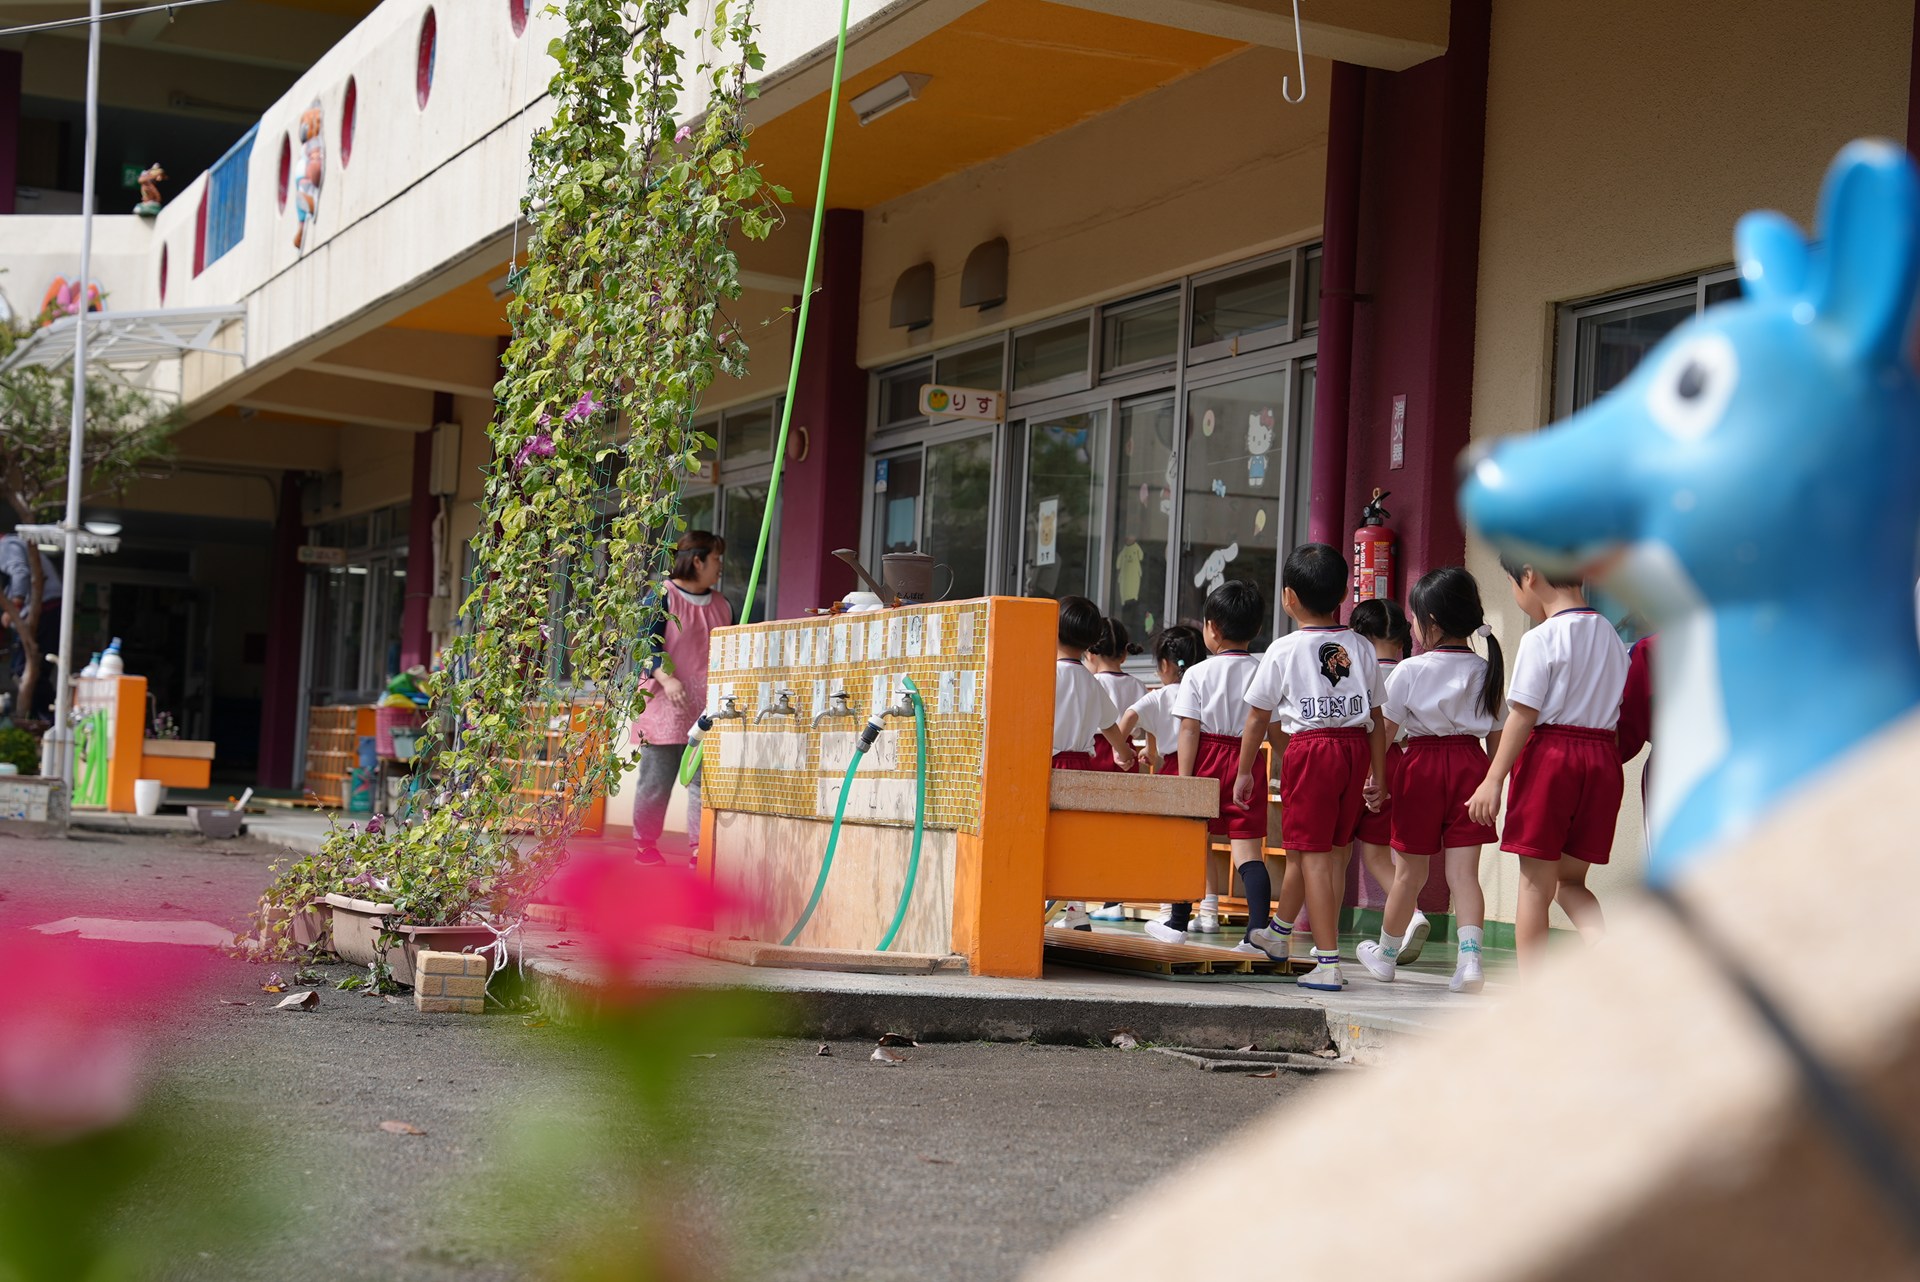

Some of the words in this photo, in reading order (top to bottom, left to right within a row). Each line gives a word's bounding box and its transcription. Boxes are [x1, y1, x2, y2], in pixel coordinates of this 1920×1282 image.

[952, 393, 993, 414] りす
[1392, 400, 1405, 462] 消火器
